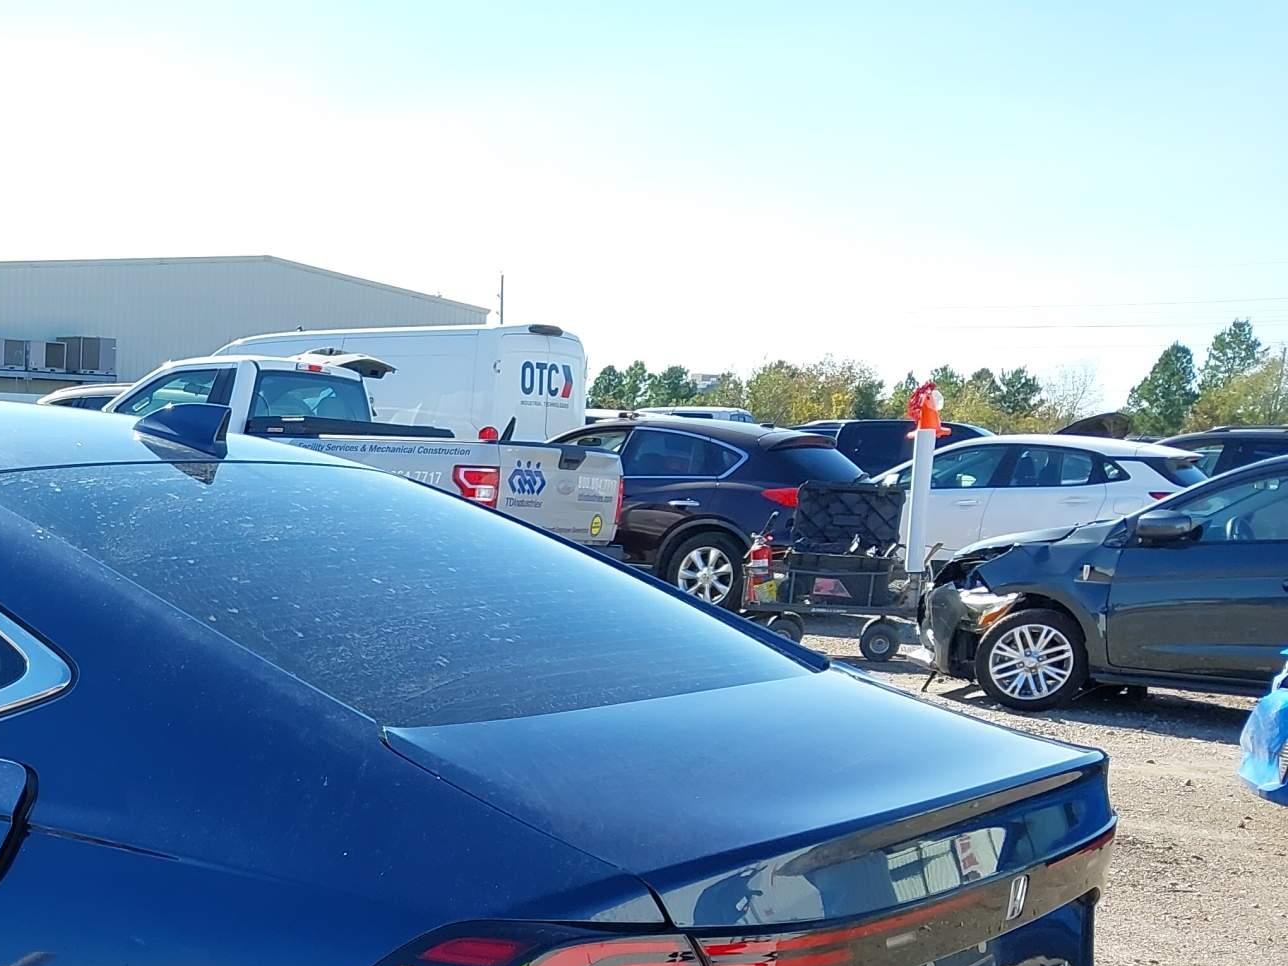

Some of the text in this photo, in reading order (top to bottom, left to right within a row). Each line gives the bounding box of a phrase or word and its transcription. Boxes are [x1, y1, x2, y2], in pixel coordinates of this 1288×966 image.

[521, 361, 559, 397] OTC
[325, 443, 359, 452] Services
[360, 444, 367, 452] &
[368, 444, 416, 454] Mechanical
[417, 445, 471, 456] Construction
